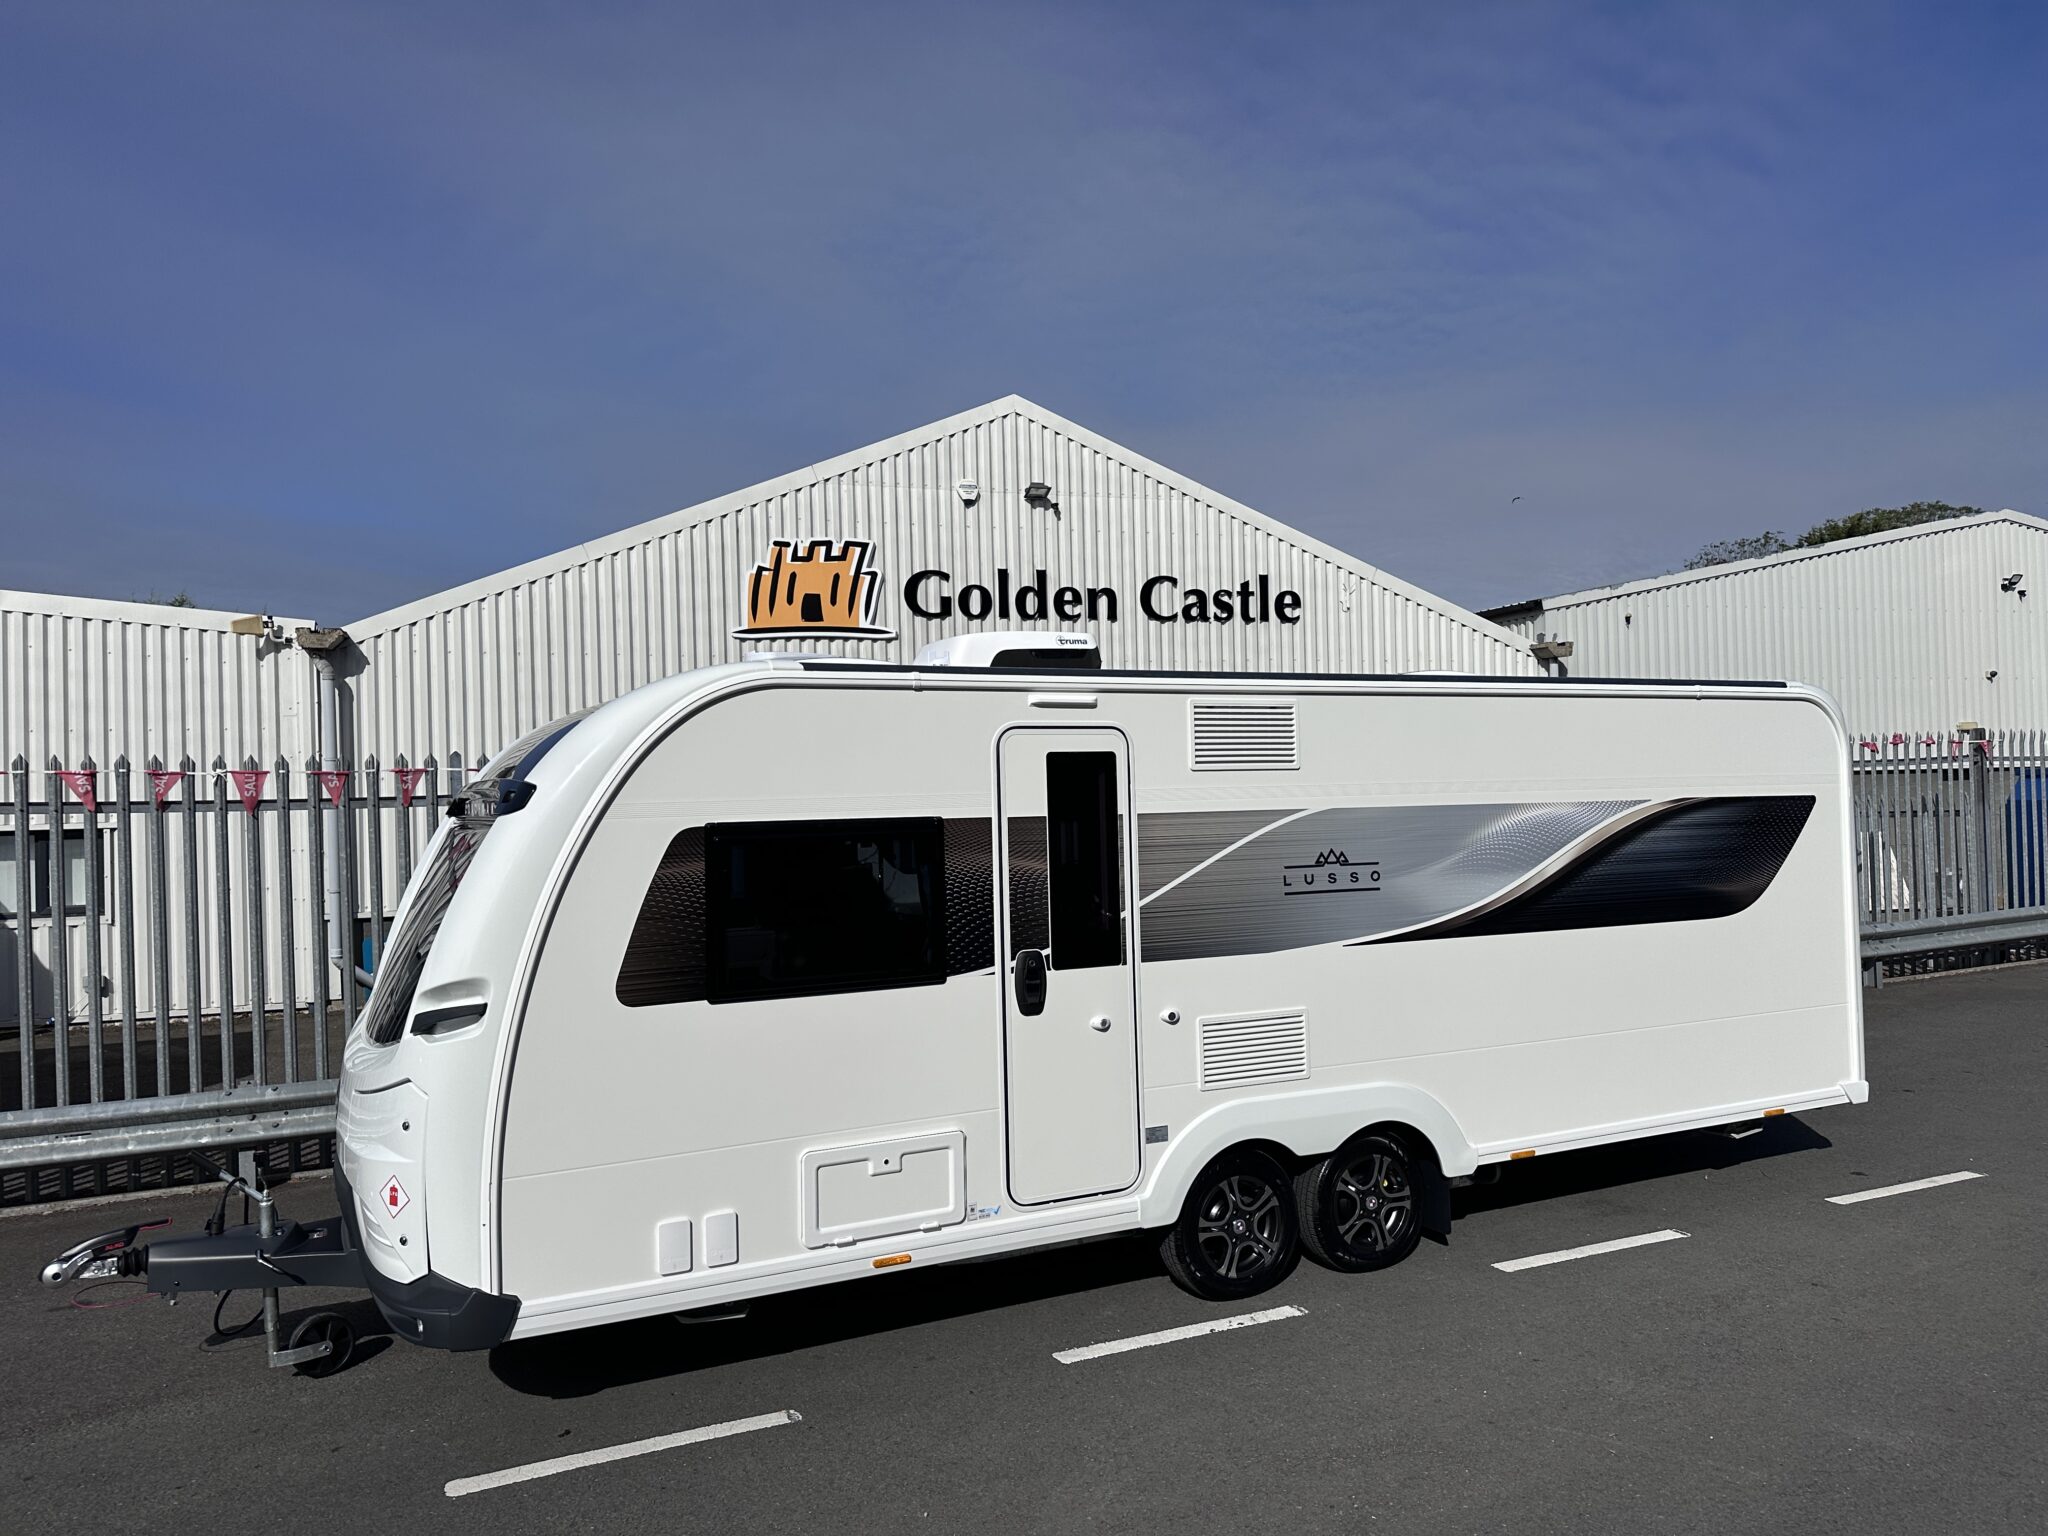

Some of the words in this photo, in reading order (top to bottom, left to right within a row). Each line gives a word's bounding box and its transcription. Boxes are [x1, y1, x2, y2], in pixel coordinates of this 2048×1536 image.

[904, 569, 1117, 622] Golden
[1140, 575, 1302, 624] Castle
[1057, 636, 1088, 645] truma
[1283, 870, 1380, 887] LUSSO
